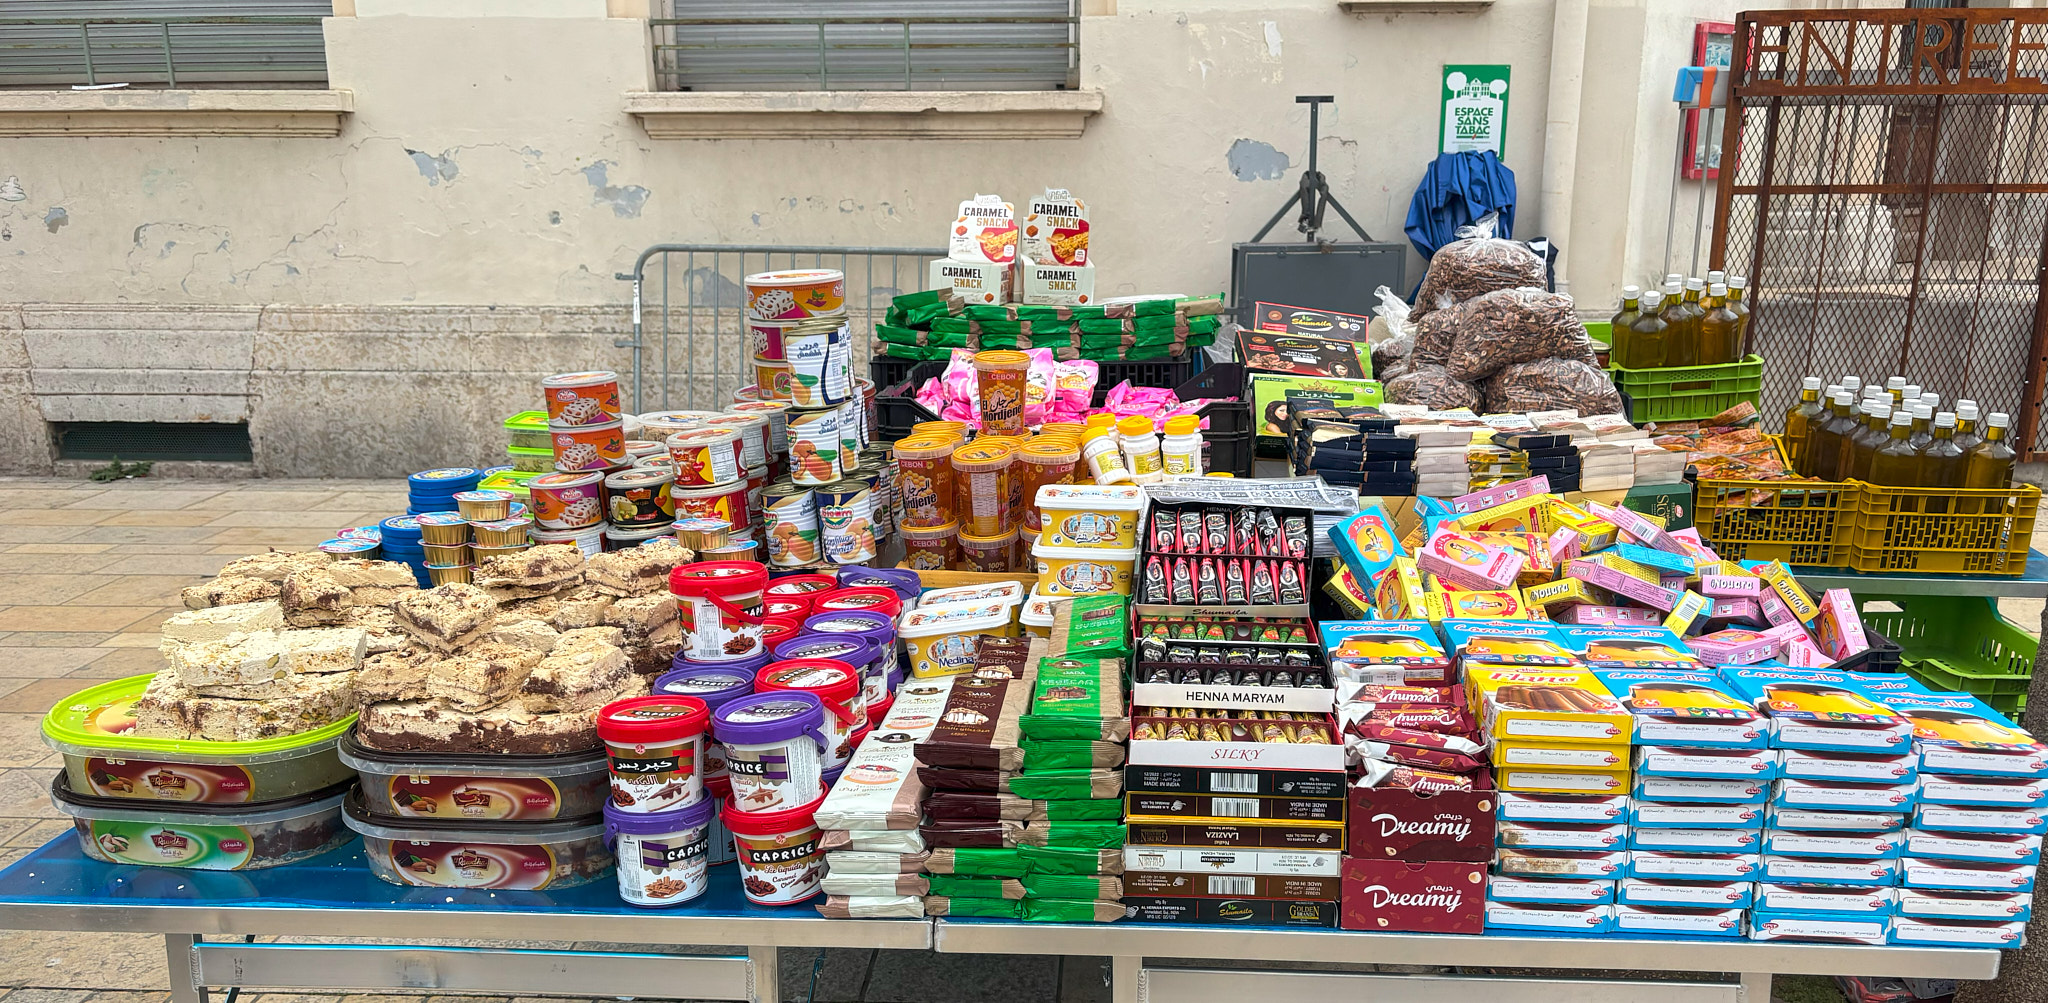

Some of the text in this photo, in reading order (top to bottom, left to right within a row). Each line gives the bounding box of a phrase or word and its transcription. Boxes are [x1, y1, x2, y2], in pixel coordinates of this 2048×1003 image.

[1454, 107, 1494, 117] ESPACE
[1457, 116, 1490, 125] SANS
[1455, 125, 1491, 135] TABAC
[964, 207, 1009, 218] CARAMEL
[1033, 203, 1080, 217] CARAMEL
[976, 217, 1009, 227] SNACK
[1046, 216, 1079, 229] SNACK
[942, 266, 983, 279] CARAMEL
[1036, 270, 1077, 281] CARAMEL
[954, 277, 983, 289] SNACK
[1048, 281, 1077, 291] SNACK
[1291, 317, 1332, 327] Shumaila
[1297, 331, 1324, 339] NATURAL
[982, 399, 988, 410] El
[982, 404, 1022, 421] Mordjene
[900, 460, 924, 468] CEBON
[1711, 579, 1754, 590] Nouara
[1529, 582, 1570, 602] Nouara
[1777, 579, 1811, 615] Nouara
[1192, 608, 1249, 616] Shumaila
[938, 656, 975, 670] Medina
[1489, 672, 1580, 684] Flano
[1736, 669, 1845, 683] Caramello
[1186, 691, 1285, 704] HENNA MARYAM
[1383, 689, 1440, 704] Dreamy
[1884, 695, 1975, 710] aramello
[1396, 713, 1456, 726] Dreamy
[1210, 748, 1265, 762] SILKY
[728, 760, 764, 774] PRICE
[1433, 813, 1463, 821] دريمي
[1371, 813, 1472, 842] Dreamy
[1205, 831, 1240, 840] LAAZIZA
[667, 838, 708, 861] CAPRIC
[752, 843, 814, 862] CAPRICE
[772, 873, 797, 883] Caramel
[1425, 885, 1454, 894] دريمي
[1363, 884, 1463, 914] Dreamy
[1219, 908, 1254, 917] Shumaila
[1289, 905, 1320, 917] GOLDEN
